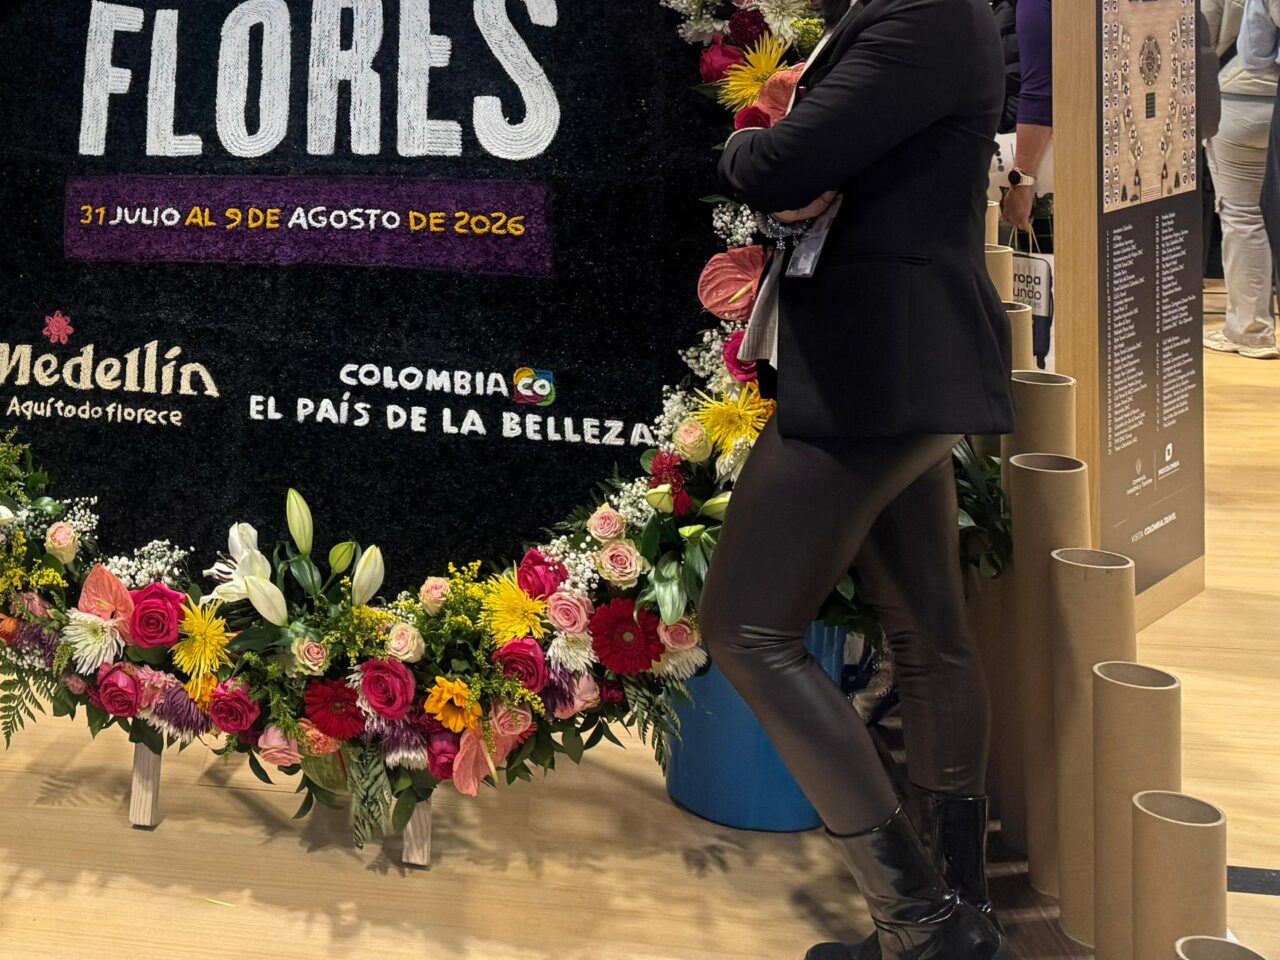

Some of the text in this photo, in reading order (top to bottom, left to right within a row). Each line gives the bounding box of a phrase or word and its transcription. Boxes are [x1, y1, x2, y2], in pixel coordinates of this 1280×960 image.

[79, 204, 526, 237] 31 JULIO AL 9 DE AGOSTO DE 2026
[339, 363, 552, 397] COLOMBIA CO
[6, 395, 183, 427] Aquí todo florece
[249, 391, 657, 447] EL PAÍS DE LA BELLEZA
